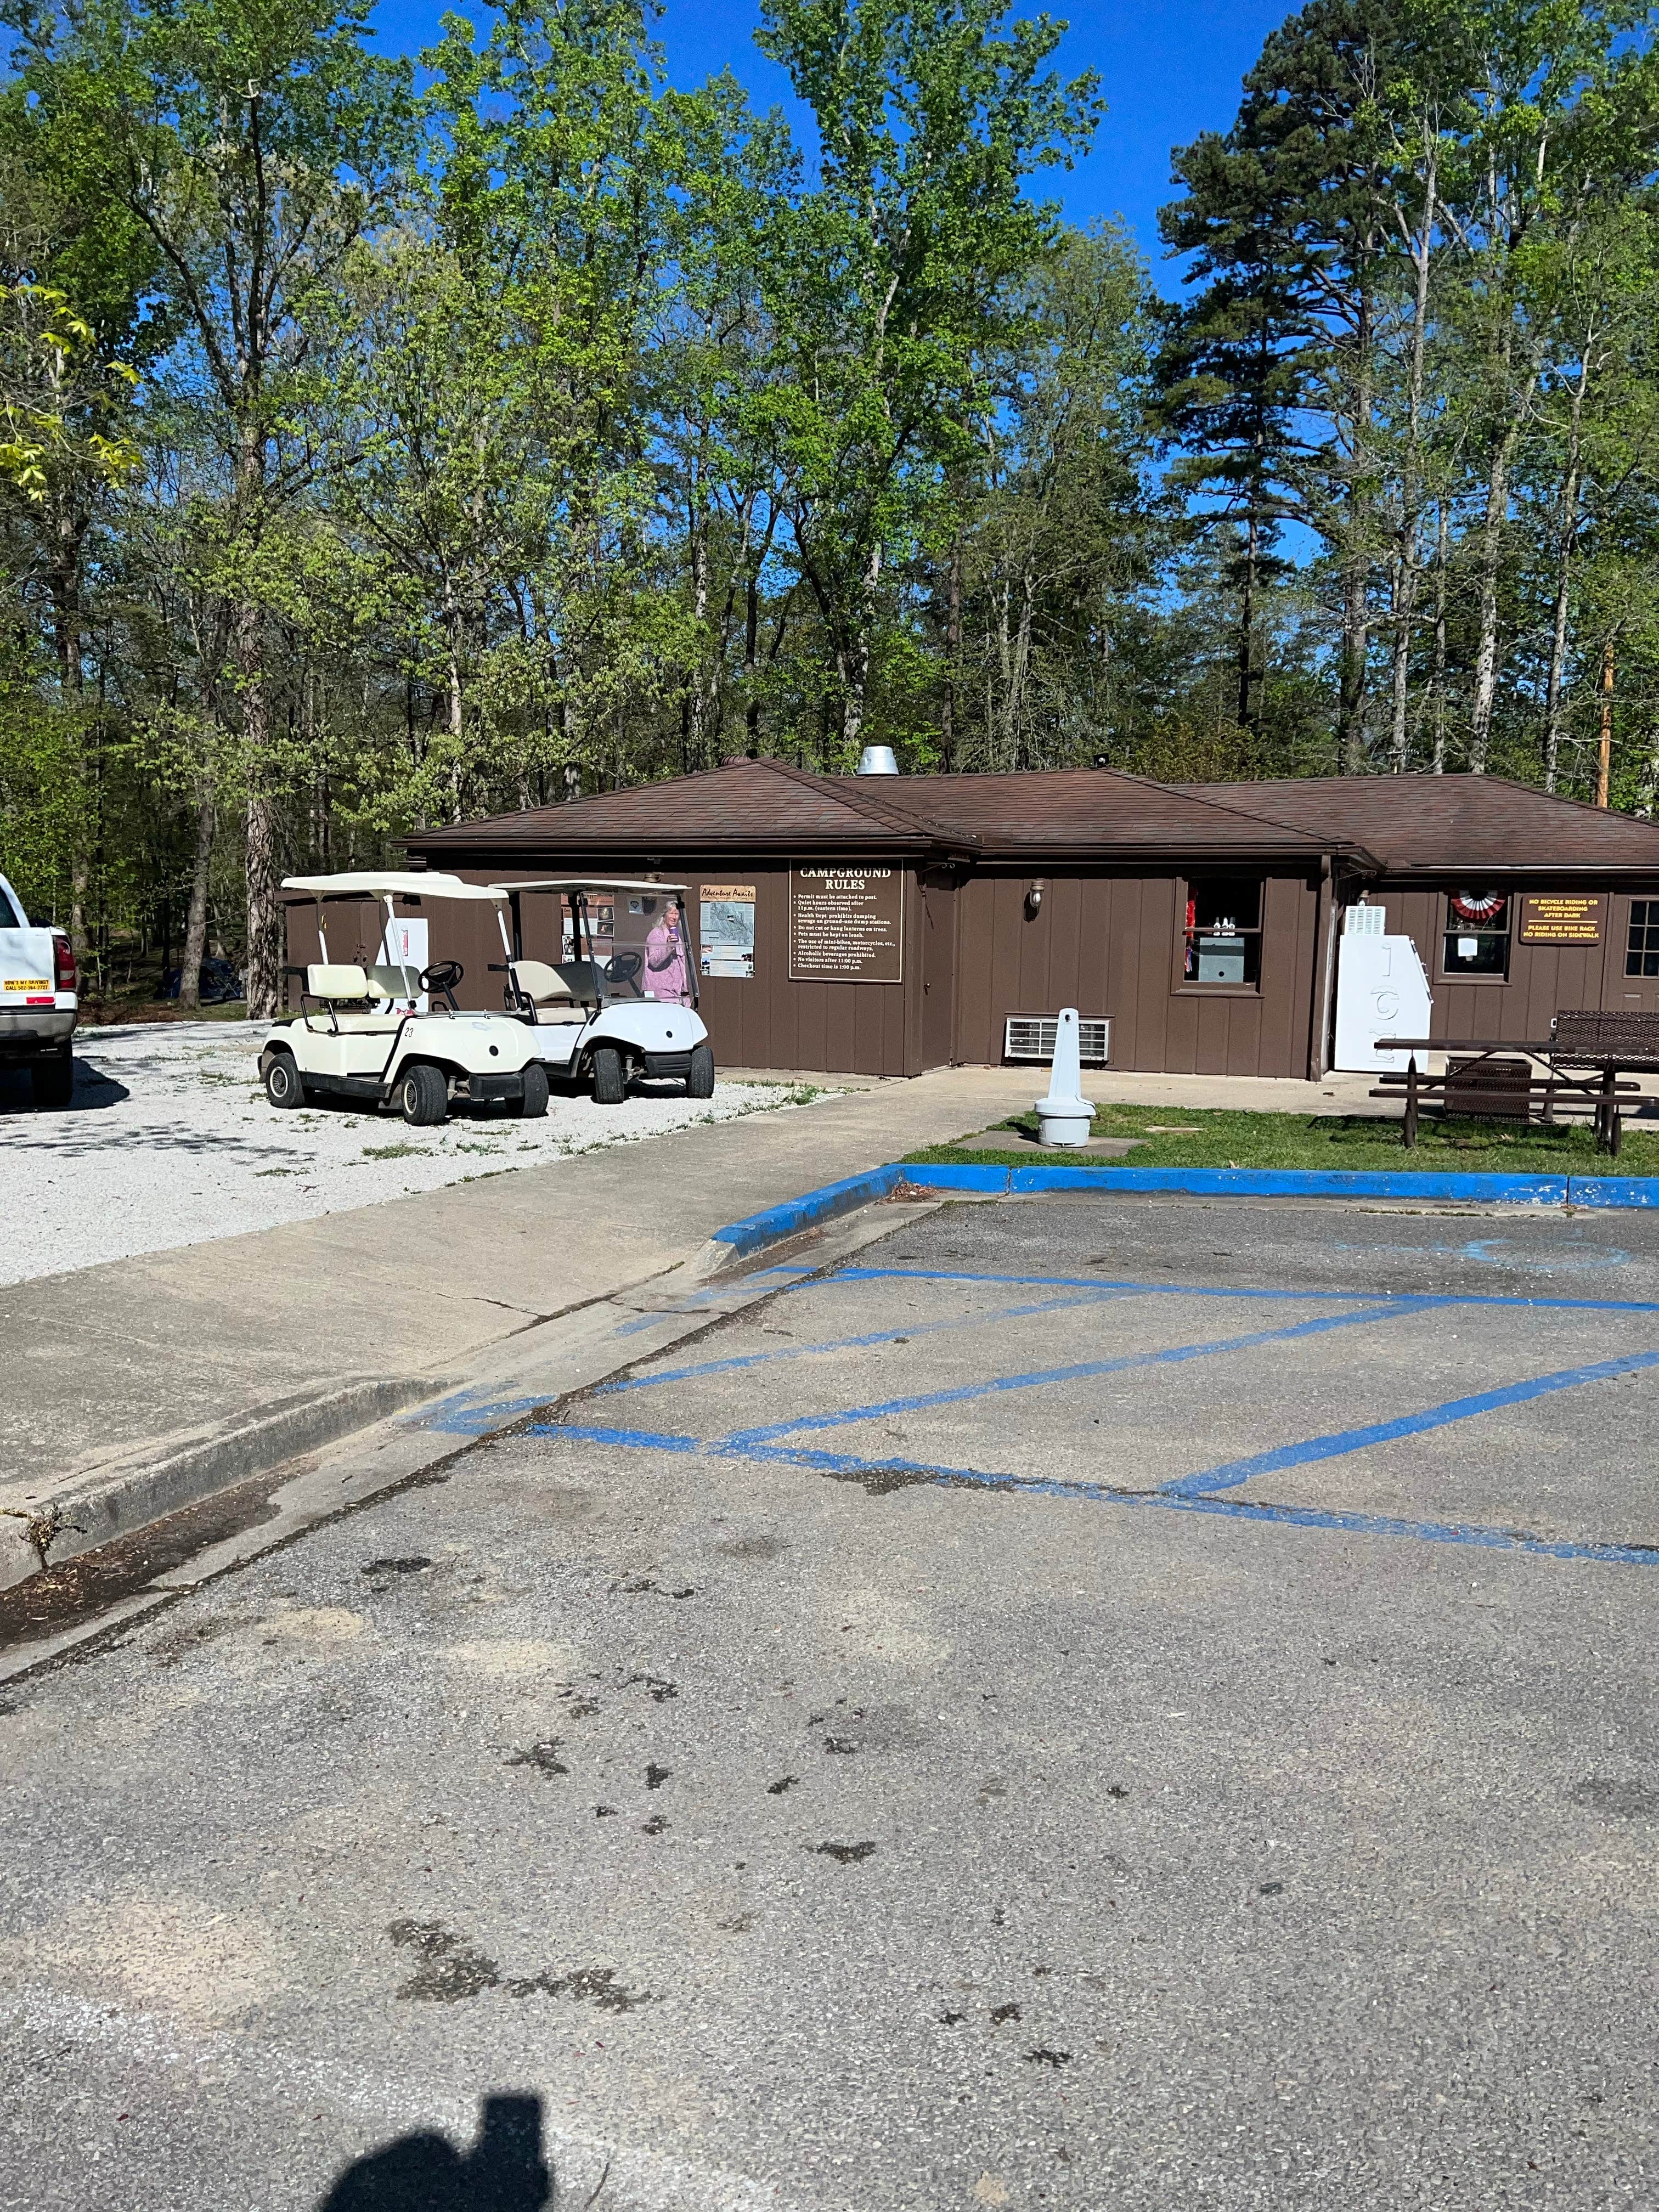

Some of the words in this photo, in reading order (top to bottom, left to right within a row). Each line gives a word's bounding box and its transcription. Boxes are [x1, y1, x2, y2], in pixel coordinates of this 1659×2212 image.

[800, 868, 891, 878] CAMPGROUND
[825, 879, 865, 890] RULES
[702, 888, 731, 896] Adventure
[732, 888, 753, 897] Awaits
[405, 1027, 414, 1037] 23
